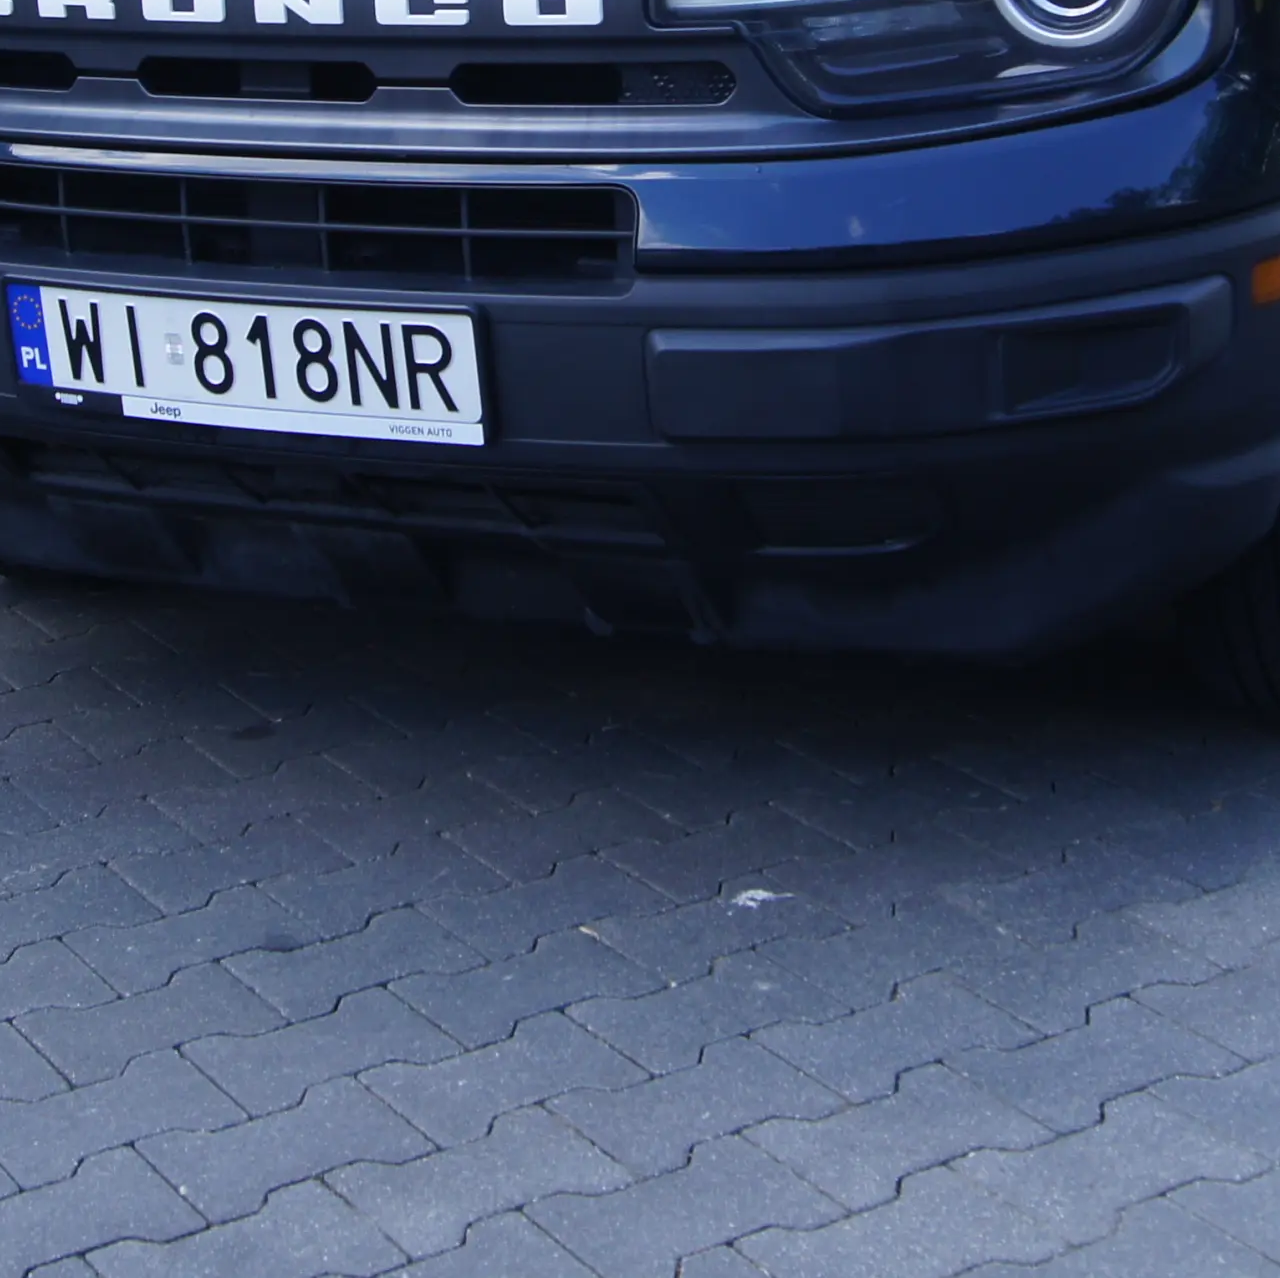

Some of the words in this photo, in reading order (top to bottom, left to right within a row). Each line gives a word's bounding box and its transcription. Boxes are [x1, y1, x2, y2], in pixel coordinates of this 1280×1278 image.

[21, 346, 48, 371] PL
[58, 298, 146, 387] WI
[190, 312, 460, 413] 818NR
[150, 402, 182, 419] Jeep
[389, 424, 424, 435] VIGGEN
[427, 426, 453, 438] AUTO
